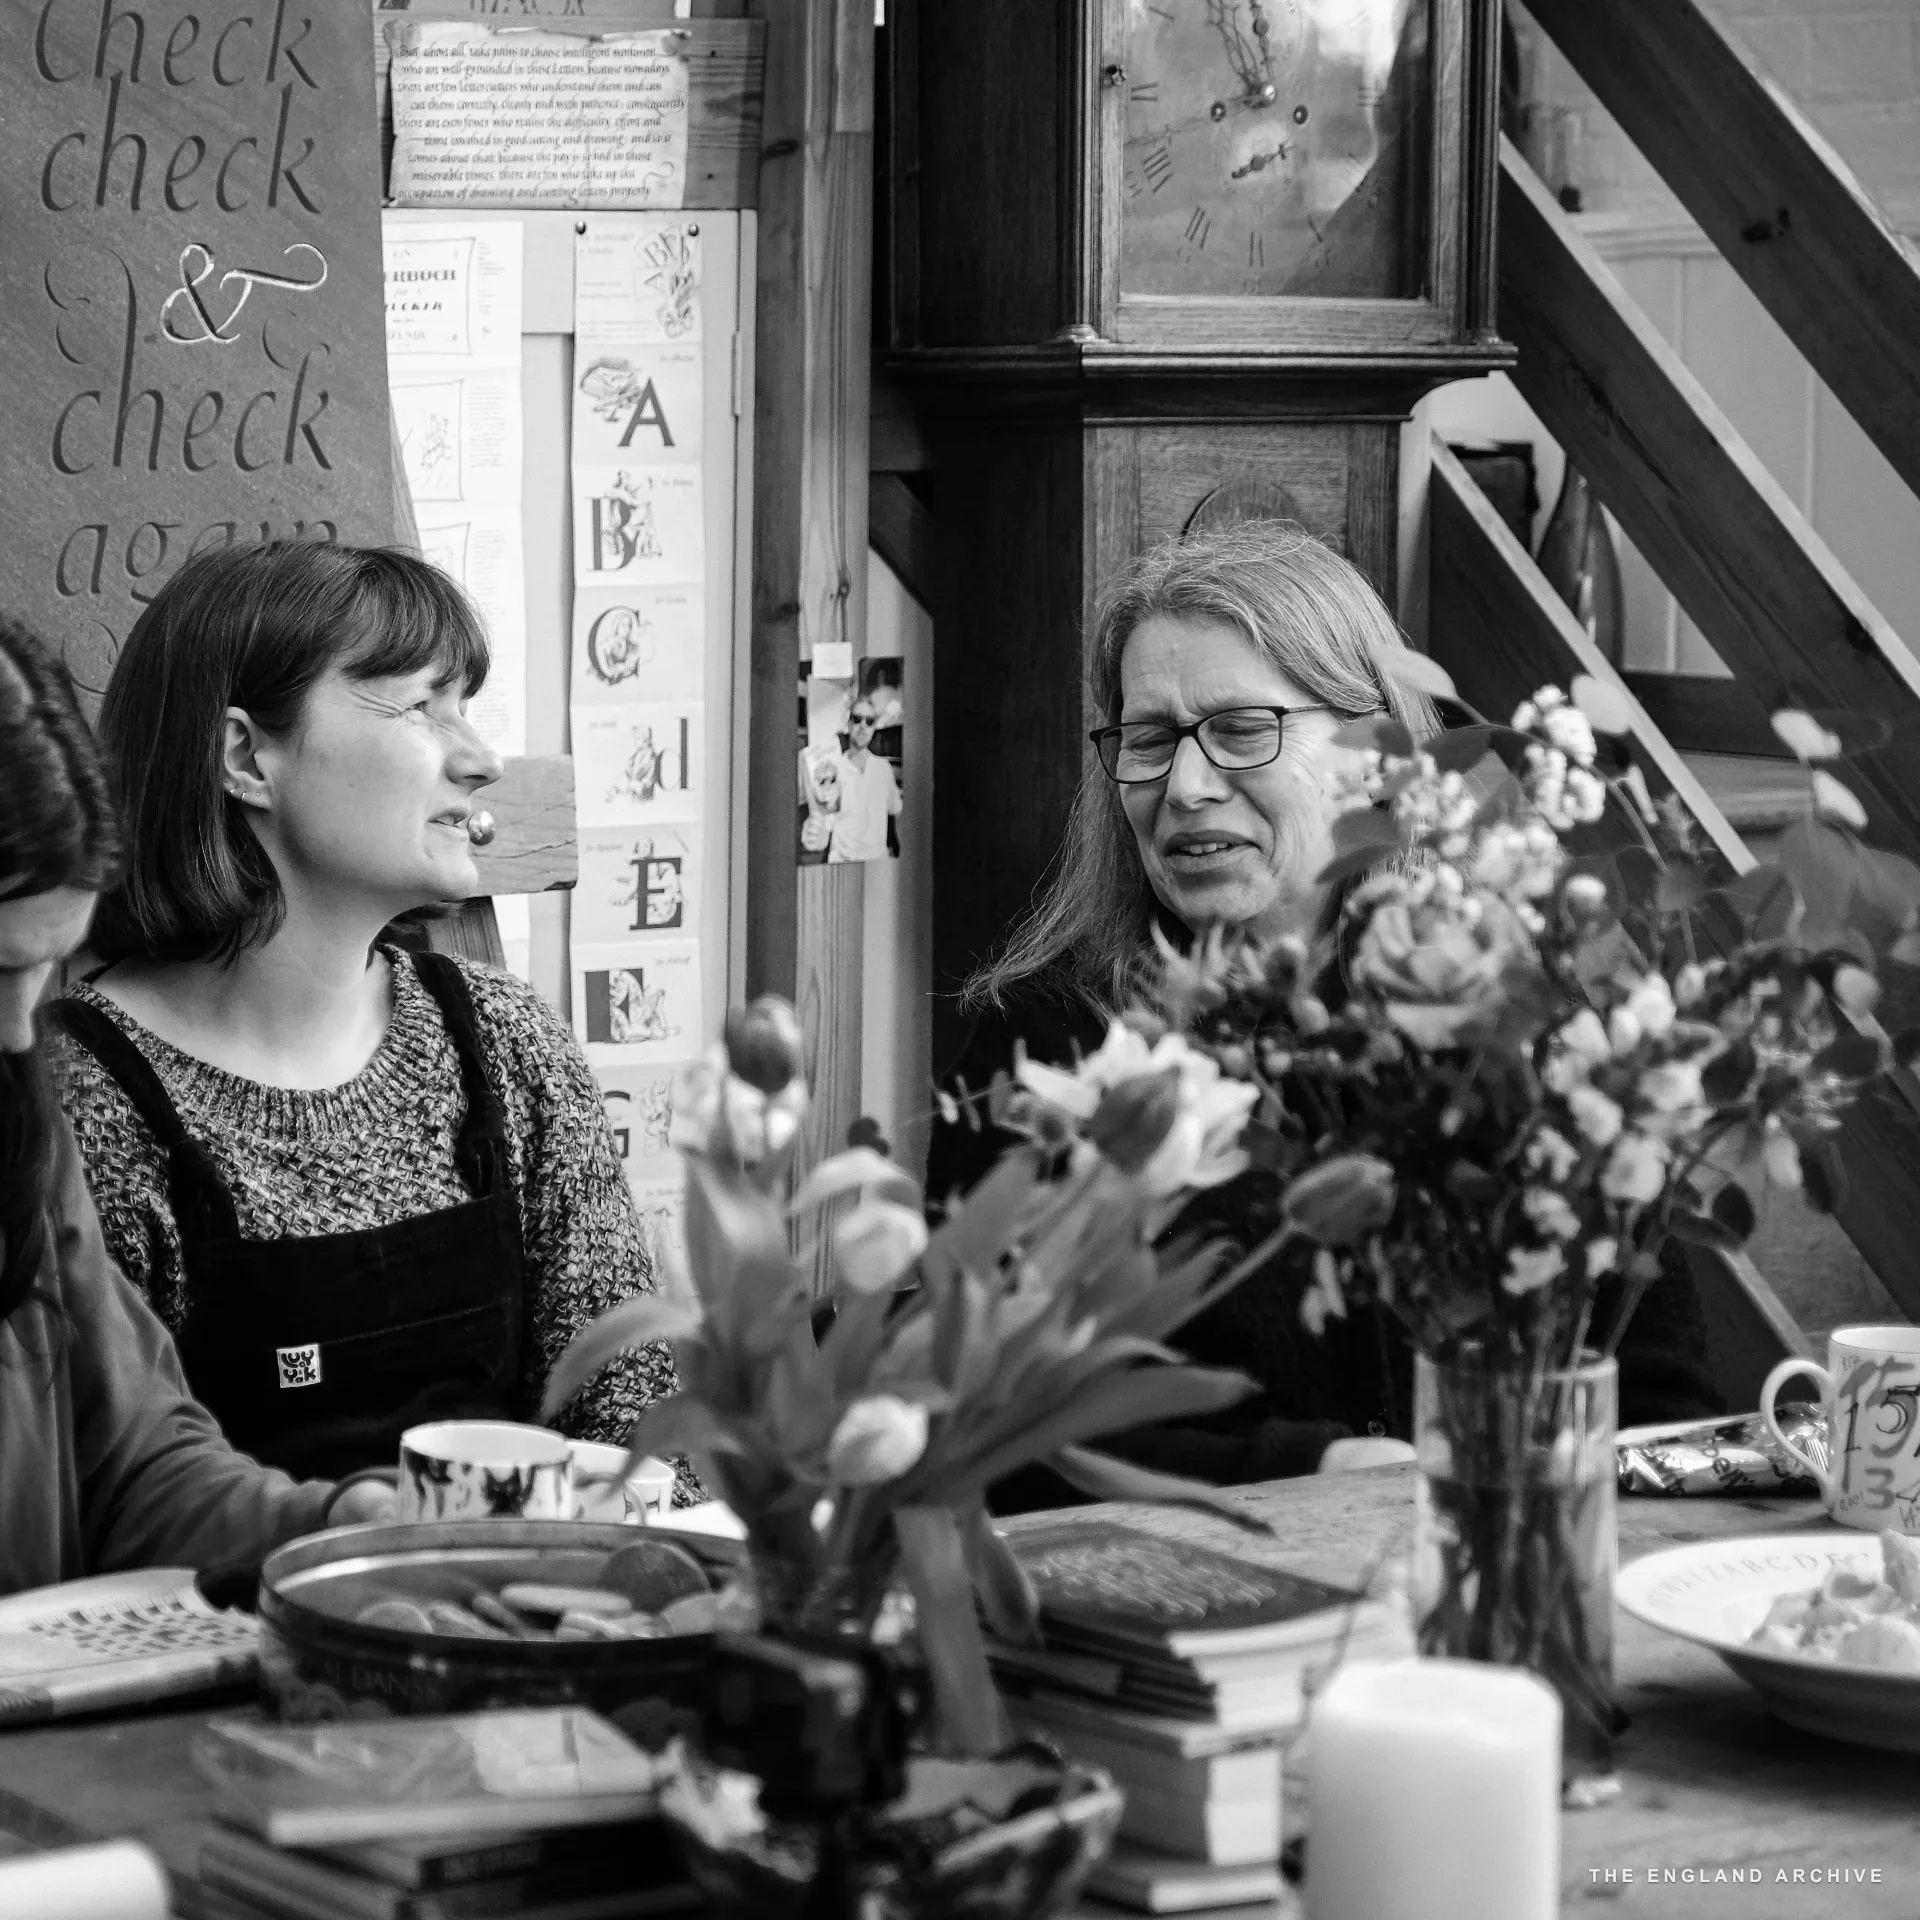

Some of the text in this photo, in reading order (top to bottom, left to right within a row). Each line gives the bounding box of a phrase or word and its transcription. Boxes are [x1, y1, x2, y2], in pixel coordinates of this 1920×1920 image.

[41, 70, 322, 214] check
[159, 242, 328, 345] &
[44, 258, 334, 474] check
[617, 376, 676, 447] A
[629, 857, 682, 931] E
